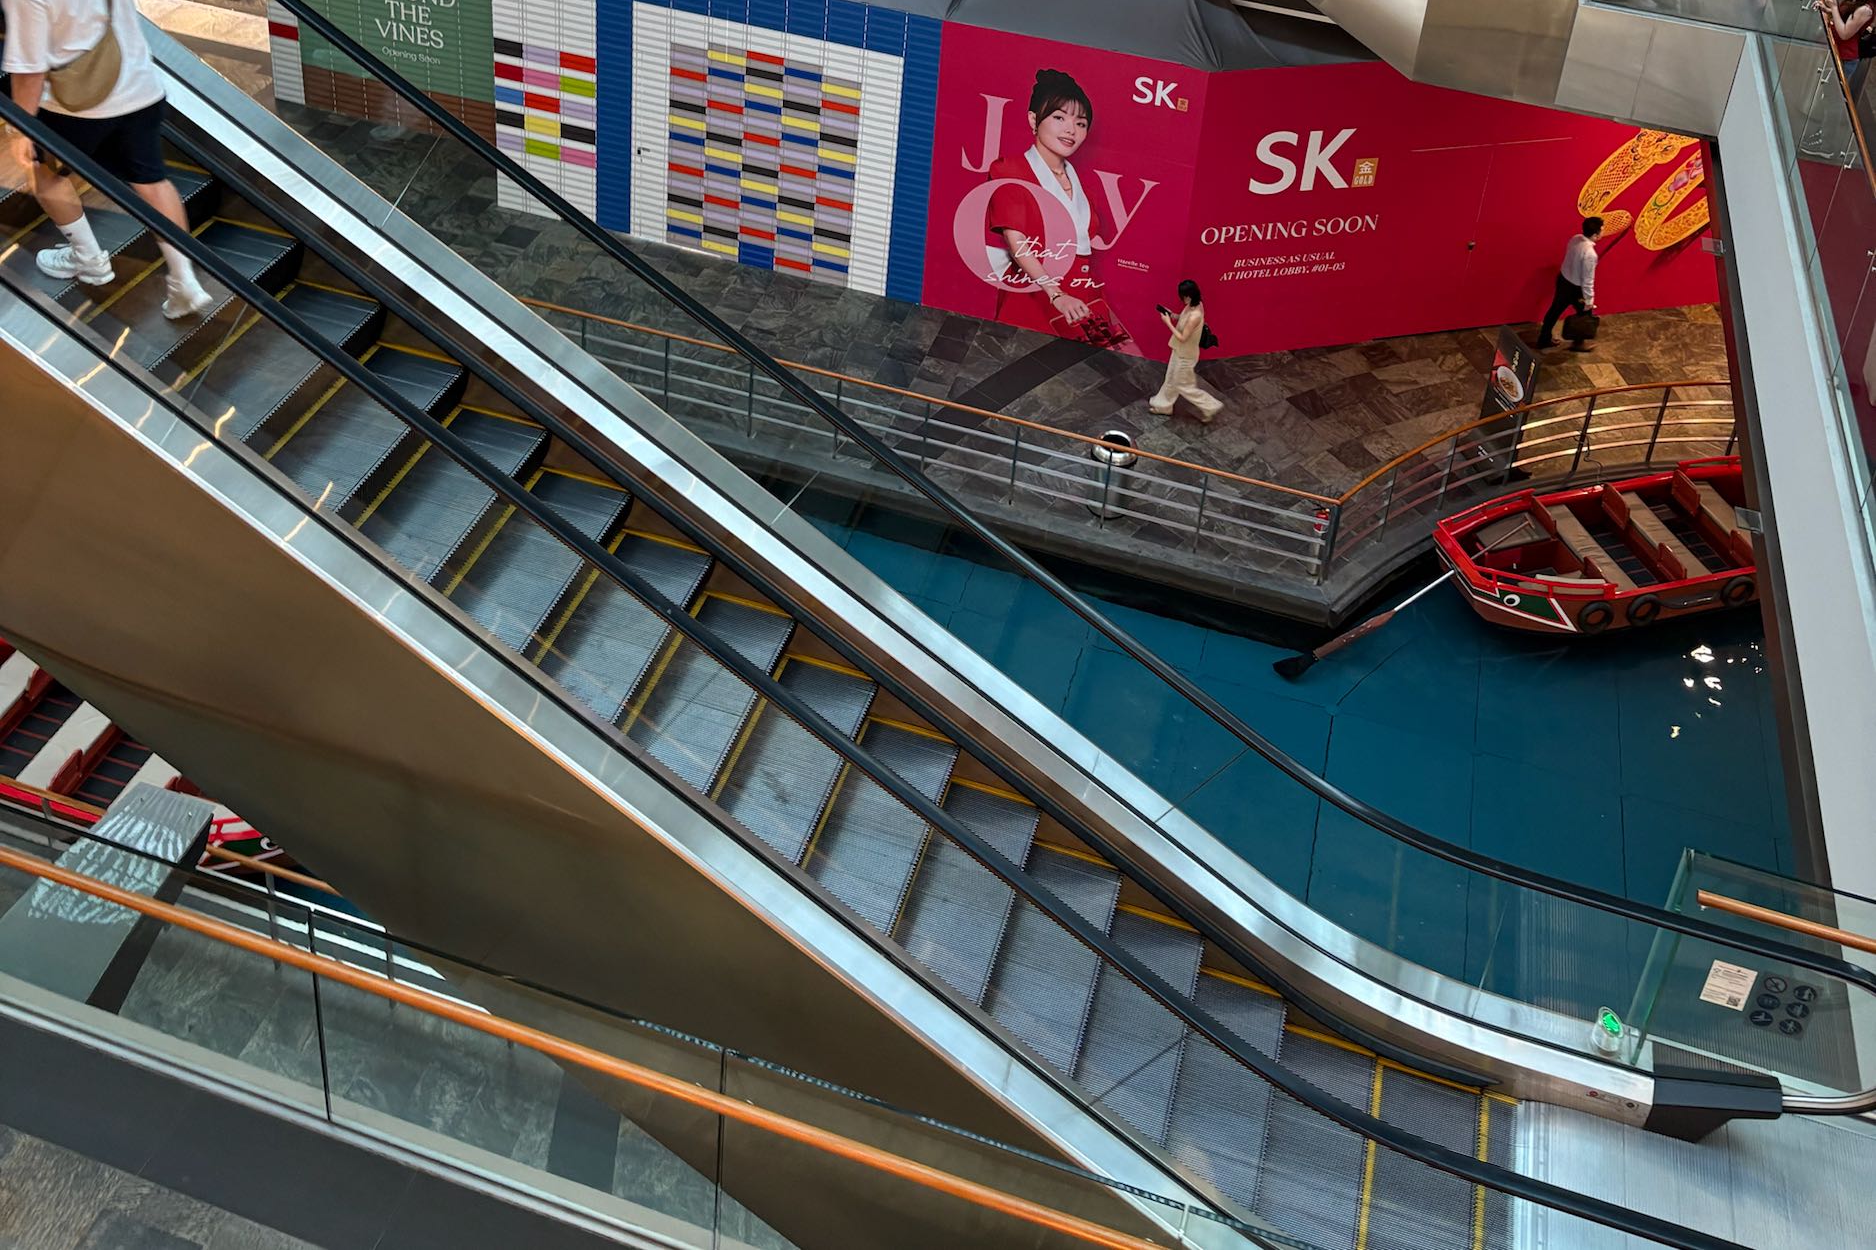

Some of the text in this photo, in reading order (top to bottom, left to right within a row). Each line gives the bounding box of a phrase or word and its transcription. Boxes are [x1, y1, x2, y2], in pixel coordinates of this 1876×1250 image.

[385, 0, 432, 26] THE
[374, 18, 444, 49] VINES
[381, 46, 440, 65] Opening Soon
[1132, 76, 1178, 110] SK
[1248, 128, 1357, 195] SK
[1353, 175, 1374, 185] GOLD
[1200, 214, 1379, 245] OPENING SOON
[1014, 236, 1077, 260] that
[1233, 251, 1336, 268] BUSINESS AS USUAL
[983, 261, 1106, 289] shines on
[1219, 271, 1234, 281] AT
[1234, 268, 1272, 280] HOTEL
[1311, 262, 1346, 273] #01-03
